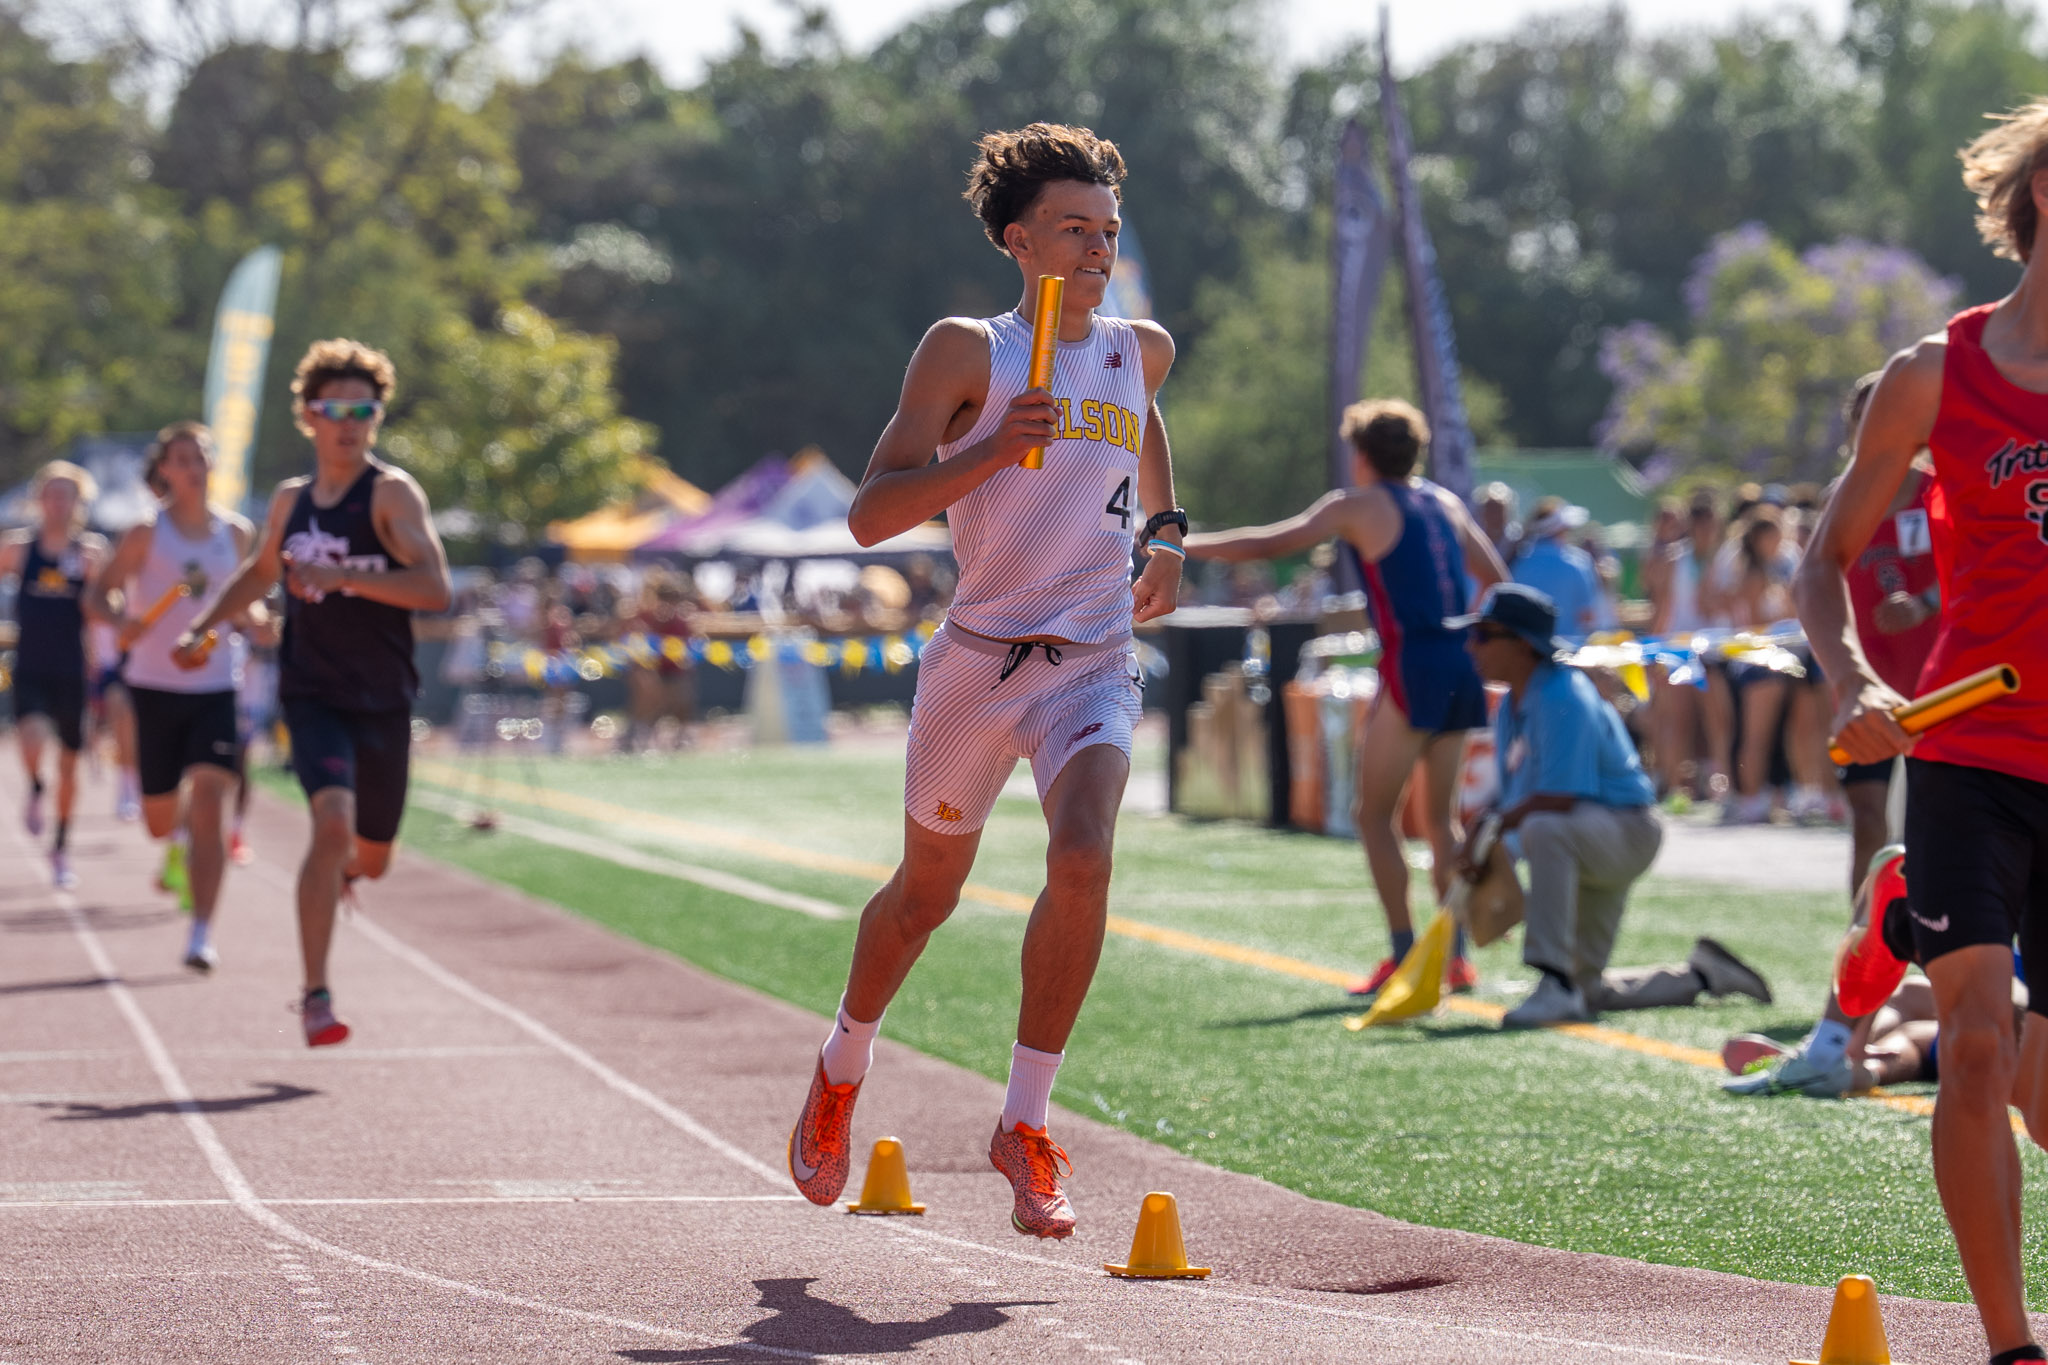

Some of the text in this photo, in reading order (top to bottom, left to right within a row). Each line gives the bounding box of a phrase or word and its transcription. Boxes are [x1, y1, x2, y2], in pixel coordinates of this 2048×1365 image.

[1984, 437, 2048, 489] Trit
[1105, 475, 1131, 530] 4
[1901, 514, 1921, 547] 7
